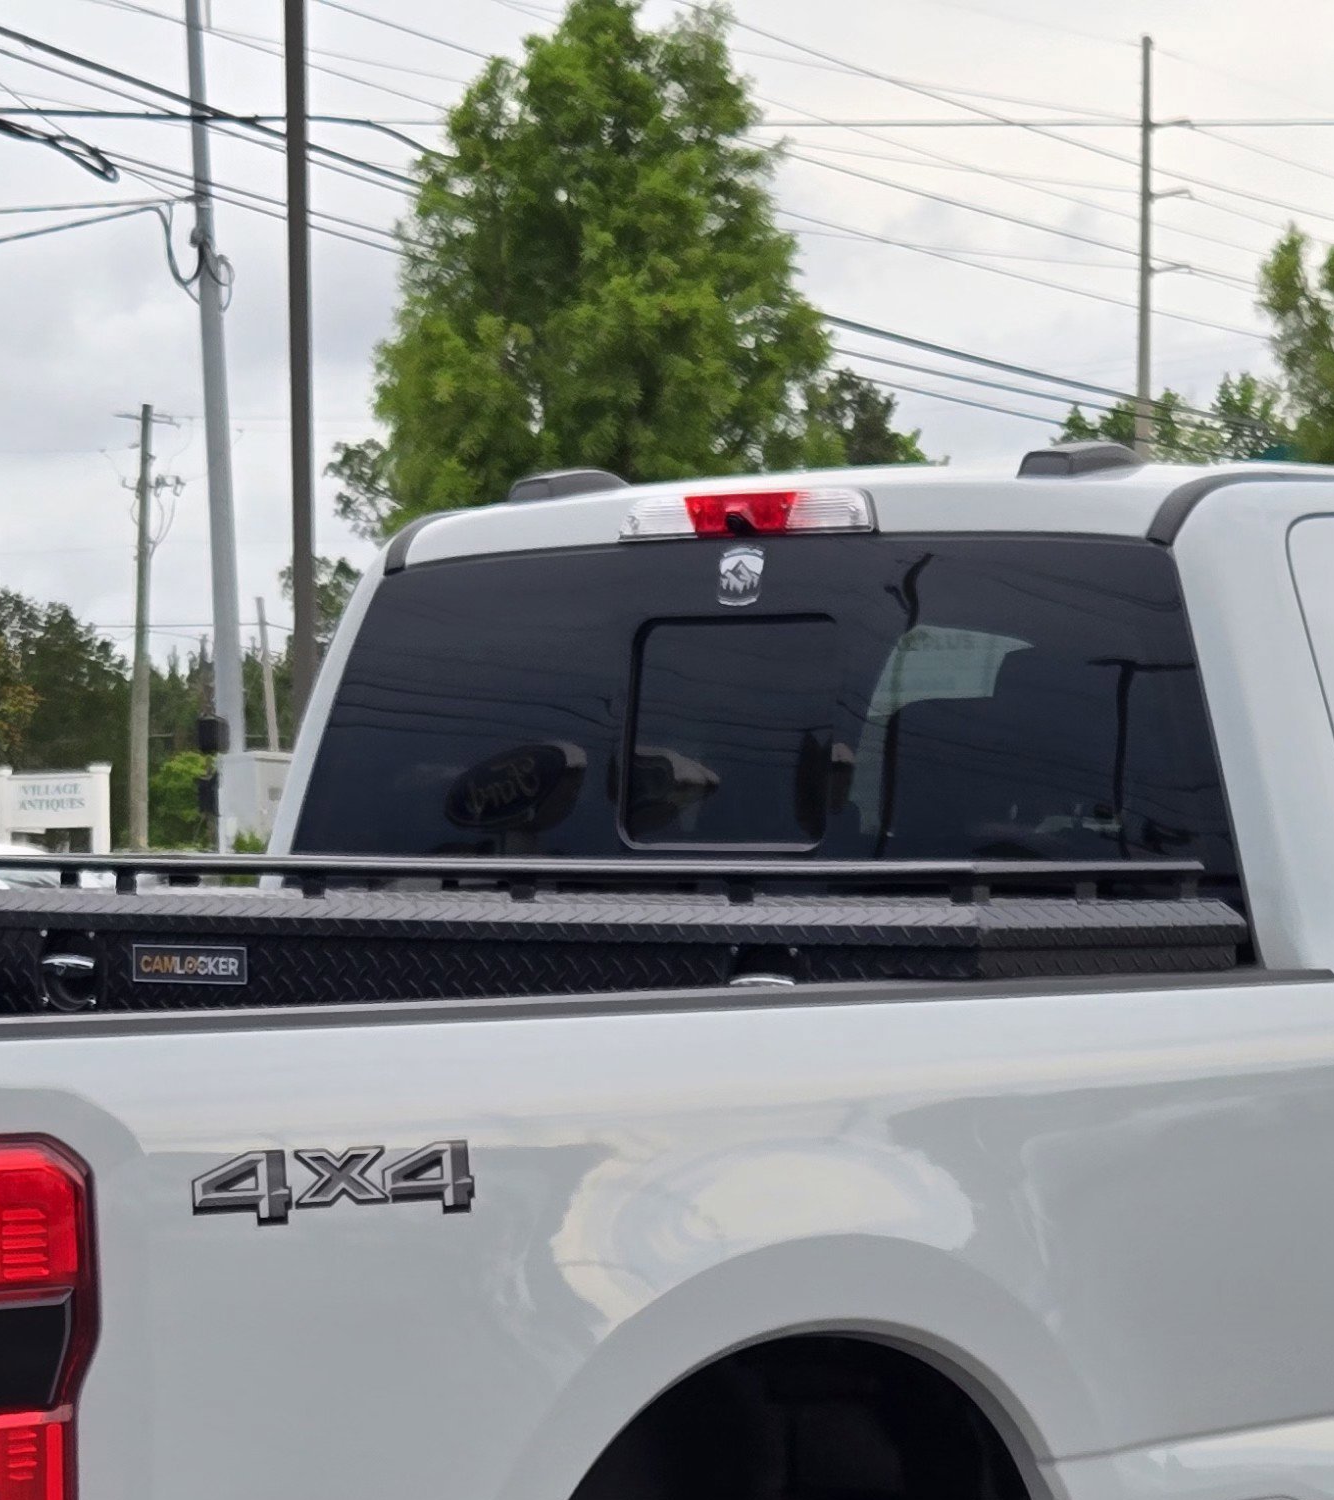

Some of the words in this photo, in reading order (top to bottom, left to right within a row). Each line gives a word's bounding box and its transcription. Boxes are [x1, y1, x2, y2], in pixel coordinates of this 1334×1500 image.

[21, 783, 82, 796] VILLAGE
[19, 798, 85, 812] ANTIQUES
[140, 955, 239, 976] CAMLOCKER
